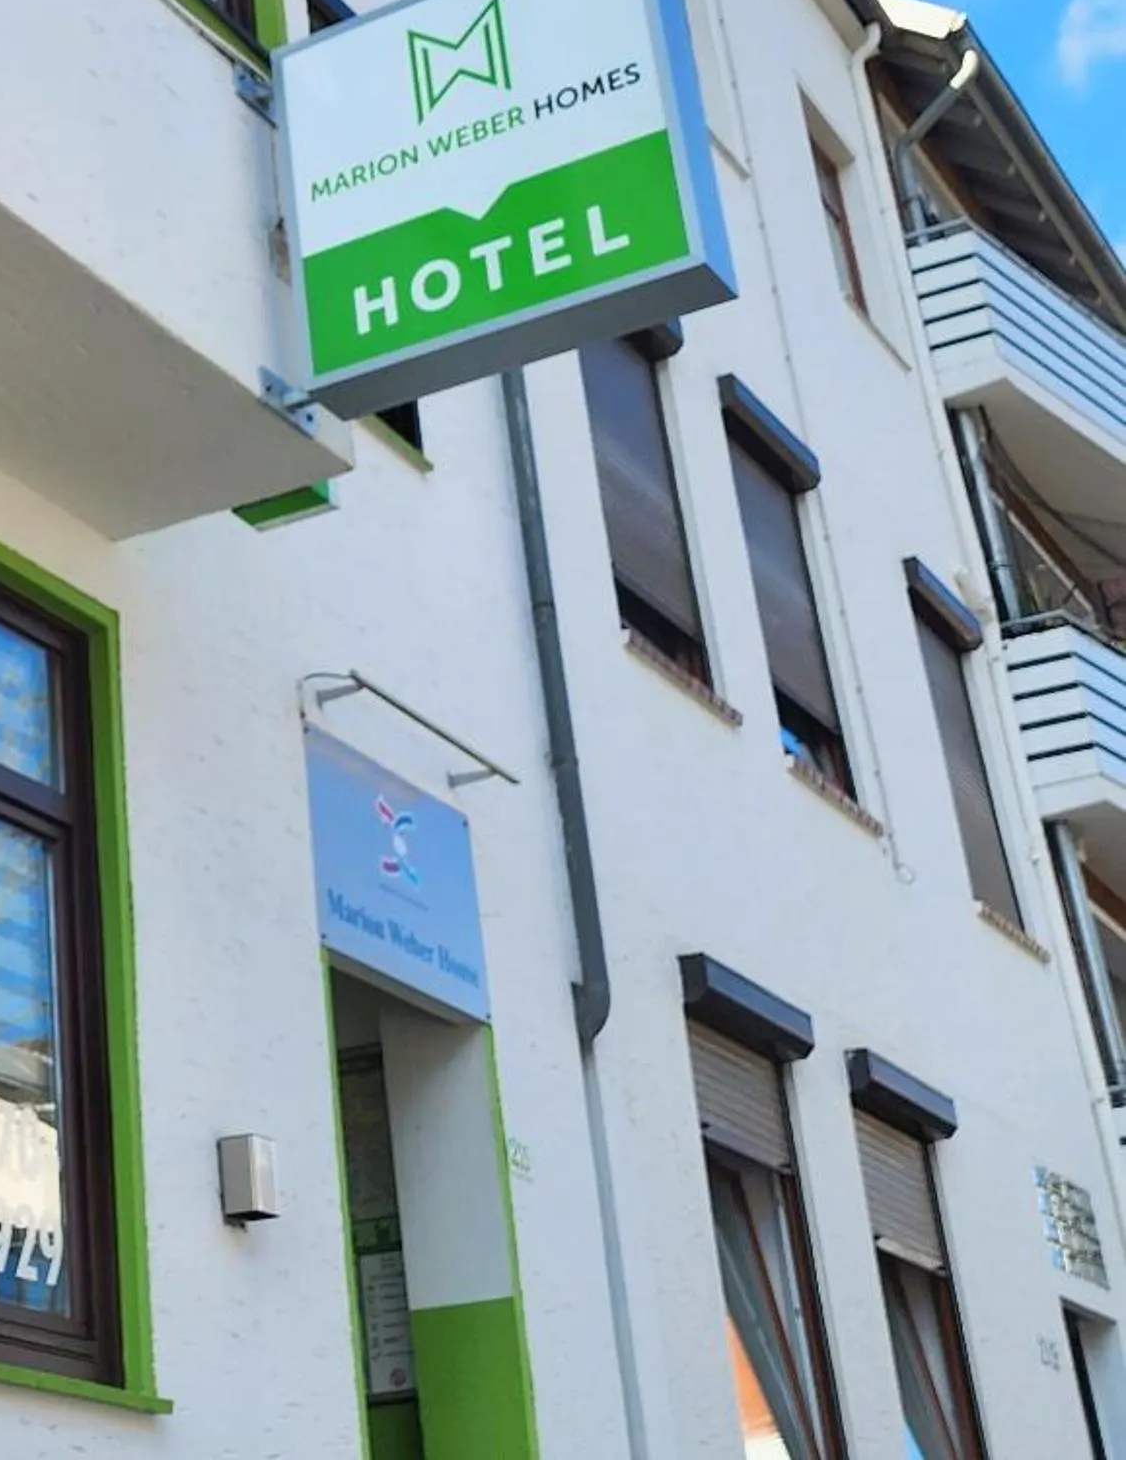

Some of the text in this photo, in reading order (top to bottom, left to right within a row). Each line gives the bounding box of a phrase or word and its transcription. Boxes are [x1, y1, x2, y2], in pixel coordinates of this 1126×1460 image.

[311, 62, 641, 202] MARION WEBER HOMES
[352, 204, 631, 336] HOTEL
